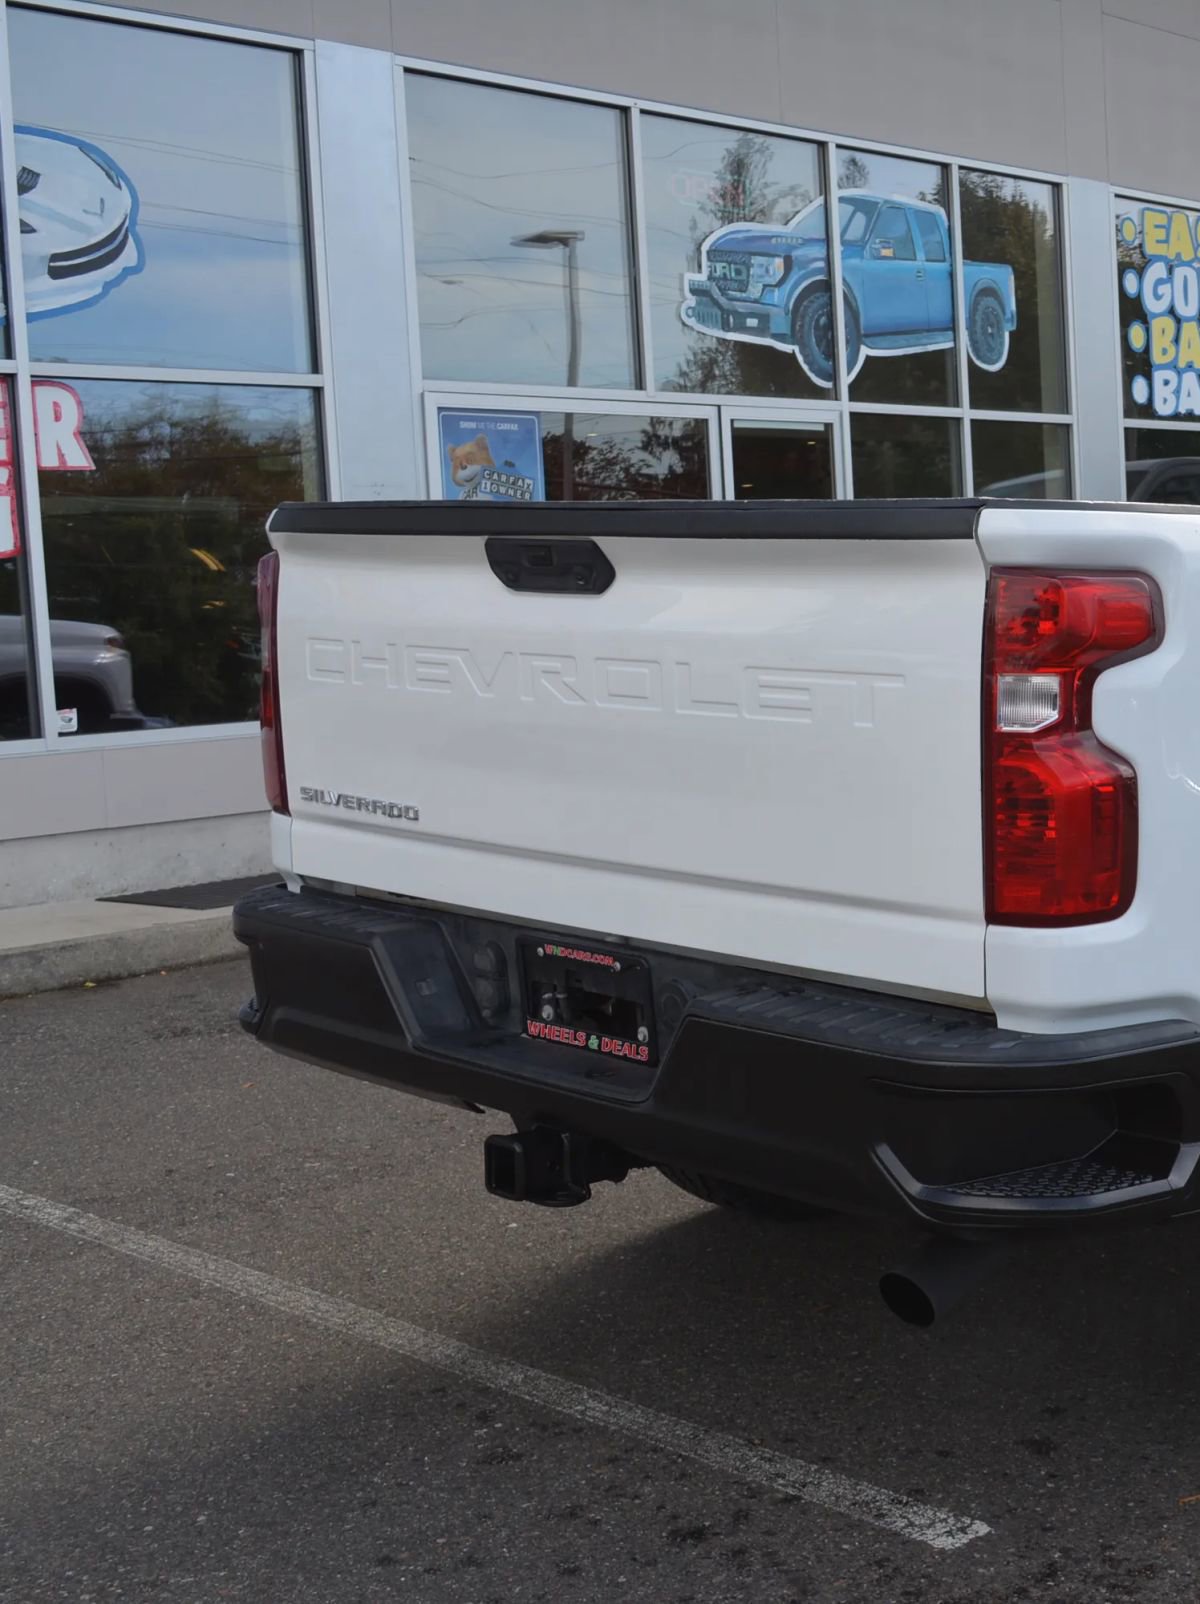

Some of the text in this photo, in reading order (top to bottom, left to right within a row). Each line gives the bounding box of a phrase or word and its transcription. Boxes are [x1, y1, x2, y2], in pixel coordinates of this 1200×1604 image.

[483, 469, 533, 492] CARFAX
[491, 483, 531, 500] OWNER
[306, 637, 907, 728] CHEVROLET
[300, 786, 419, 821] SILVERADO
[527, 1019, 649, 1062] WHEELS & DEALS
